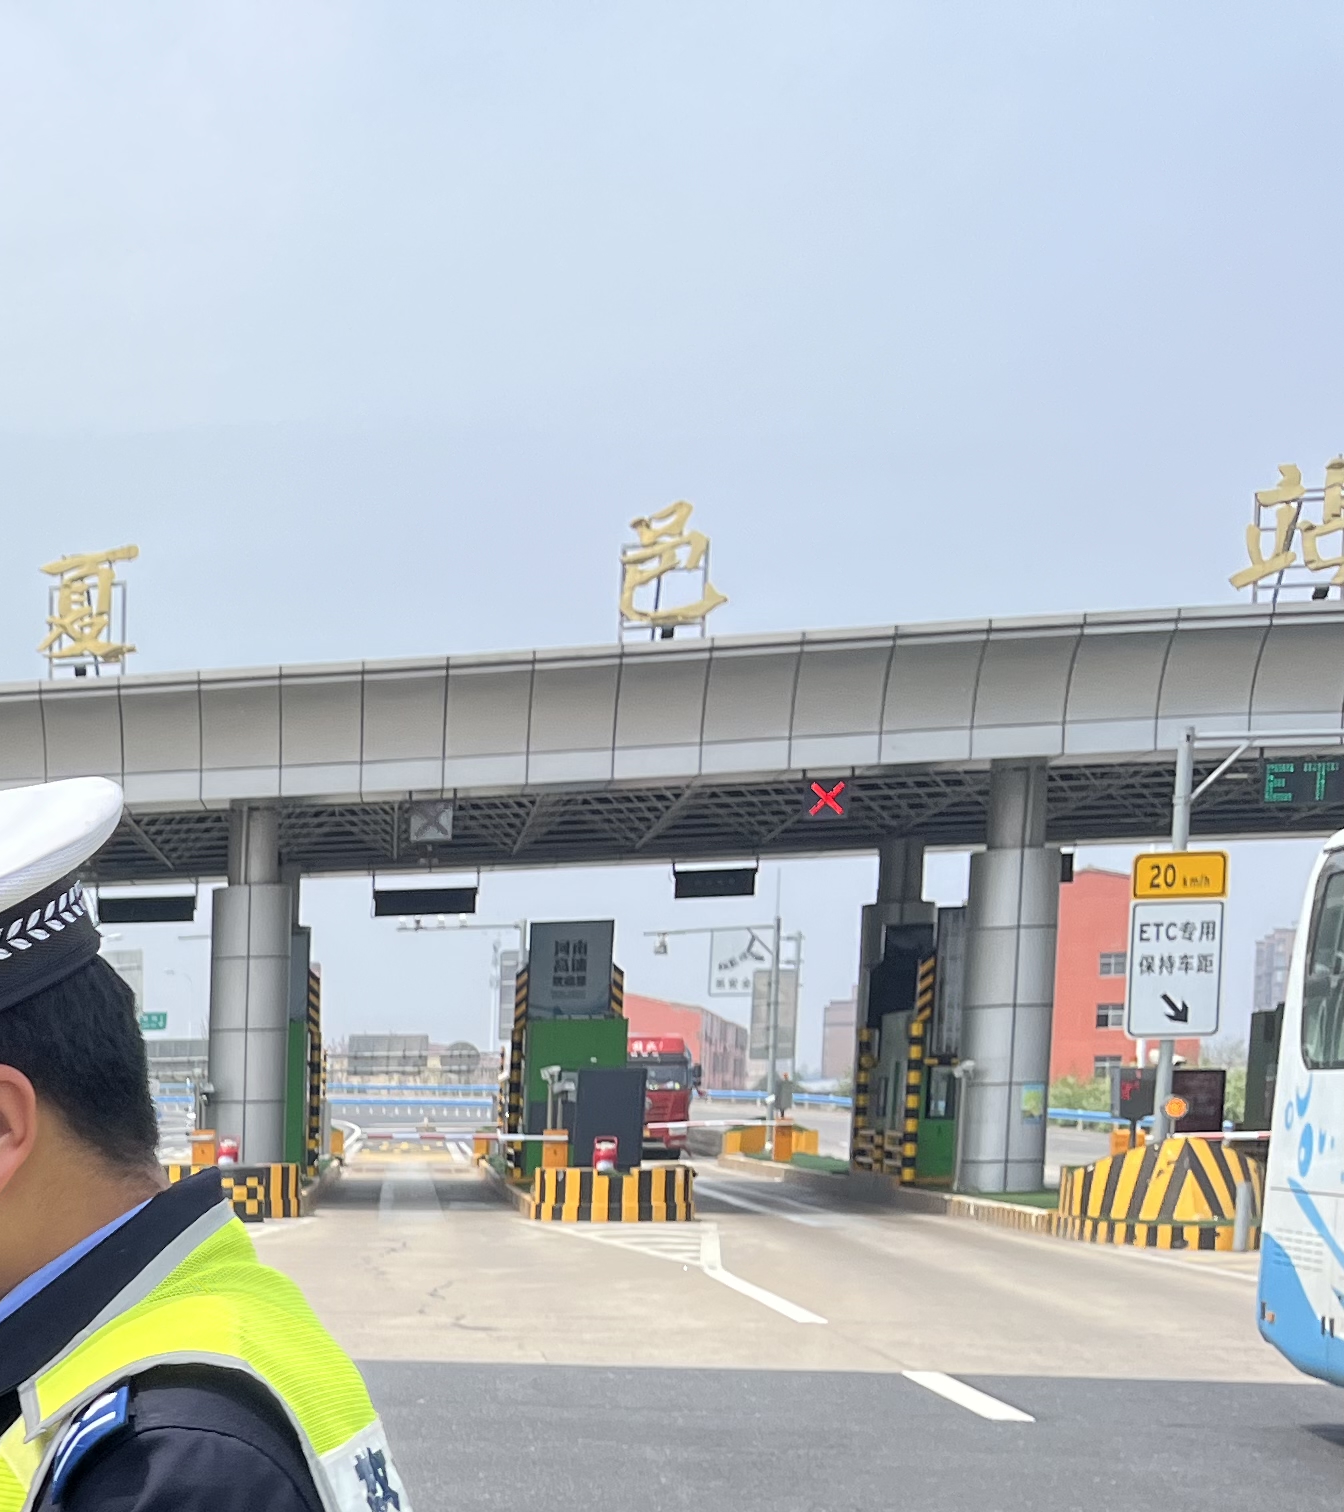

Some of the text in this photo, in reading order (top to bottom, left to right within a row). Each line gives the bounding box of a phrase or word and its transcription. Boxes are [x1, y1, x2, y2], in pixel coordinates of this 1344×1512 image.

[37, 543, 140, 663] 夏
[620, 500, 728, 624] 邑
[1149, 863, 1177, 889] 20
[1139, 953, 1214, 976] 保持车距
